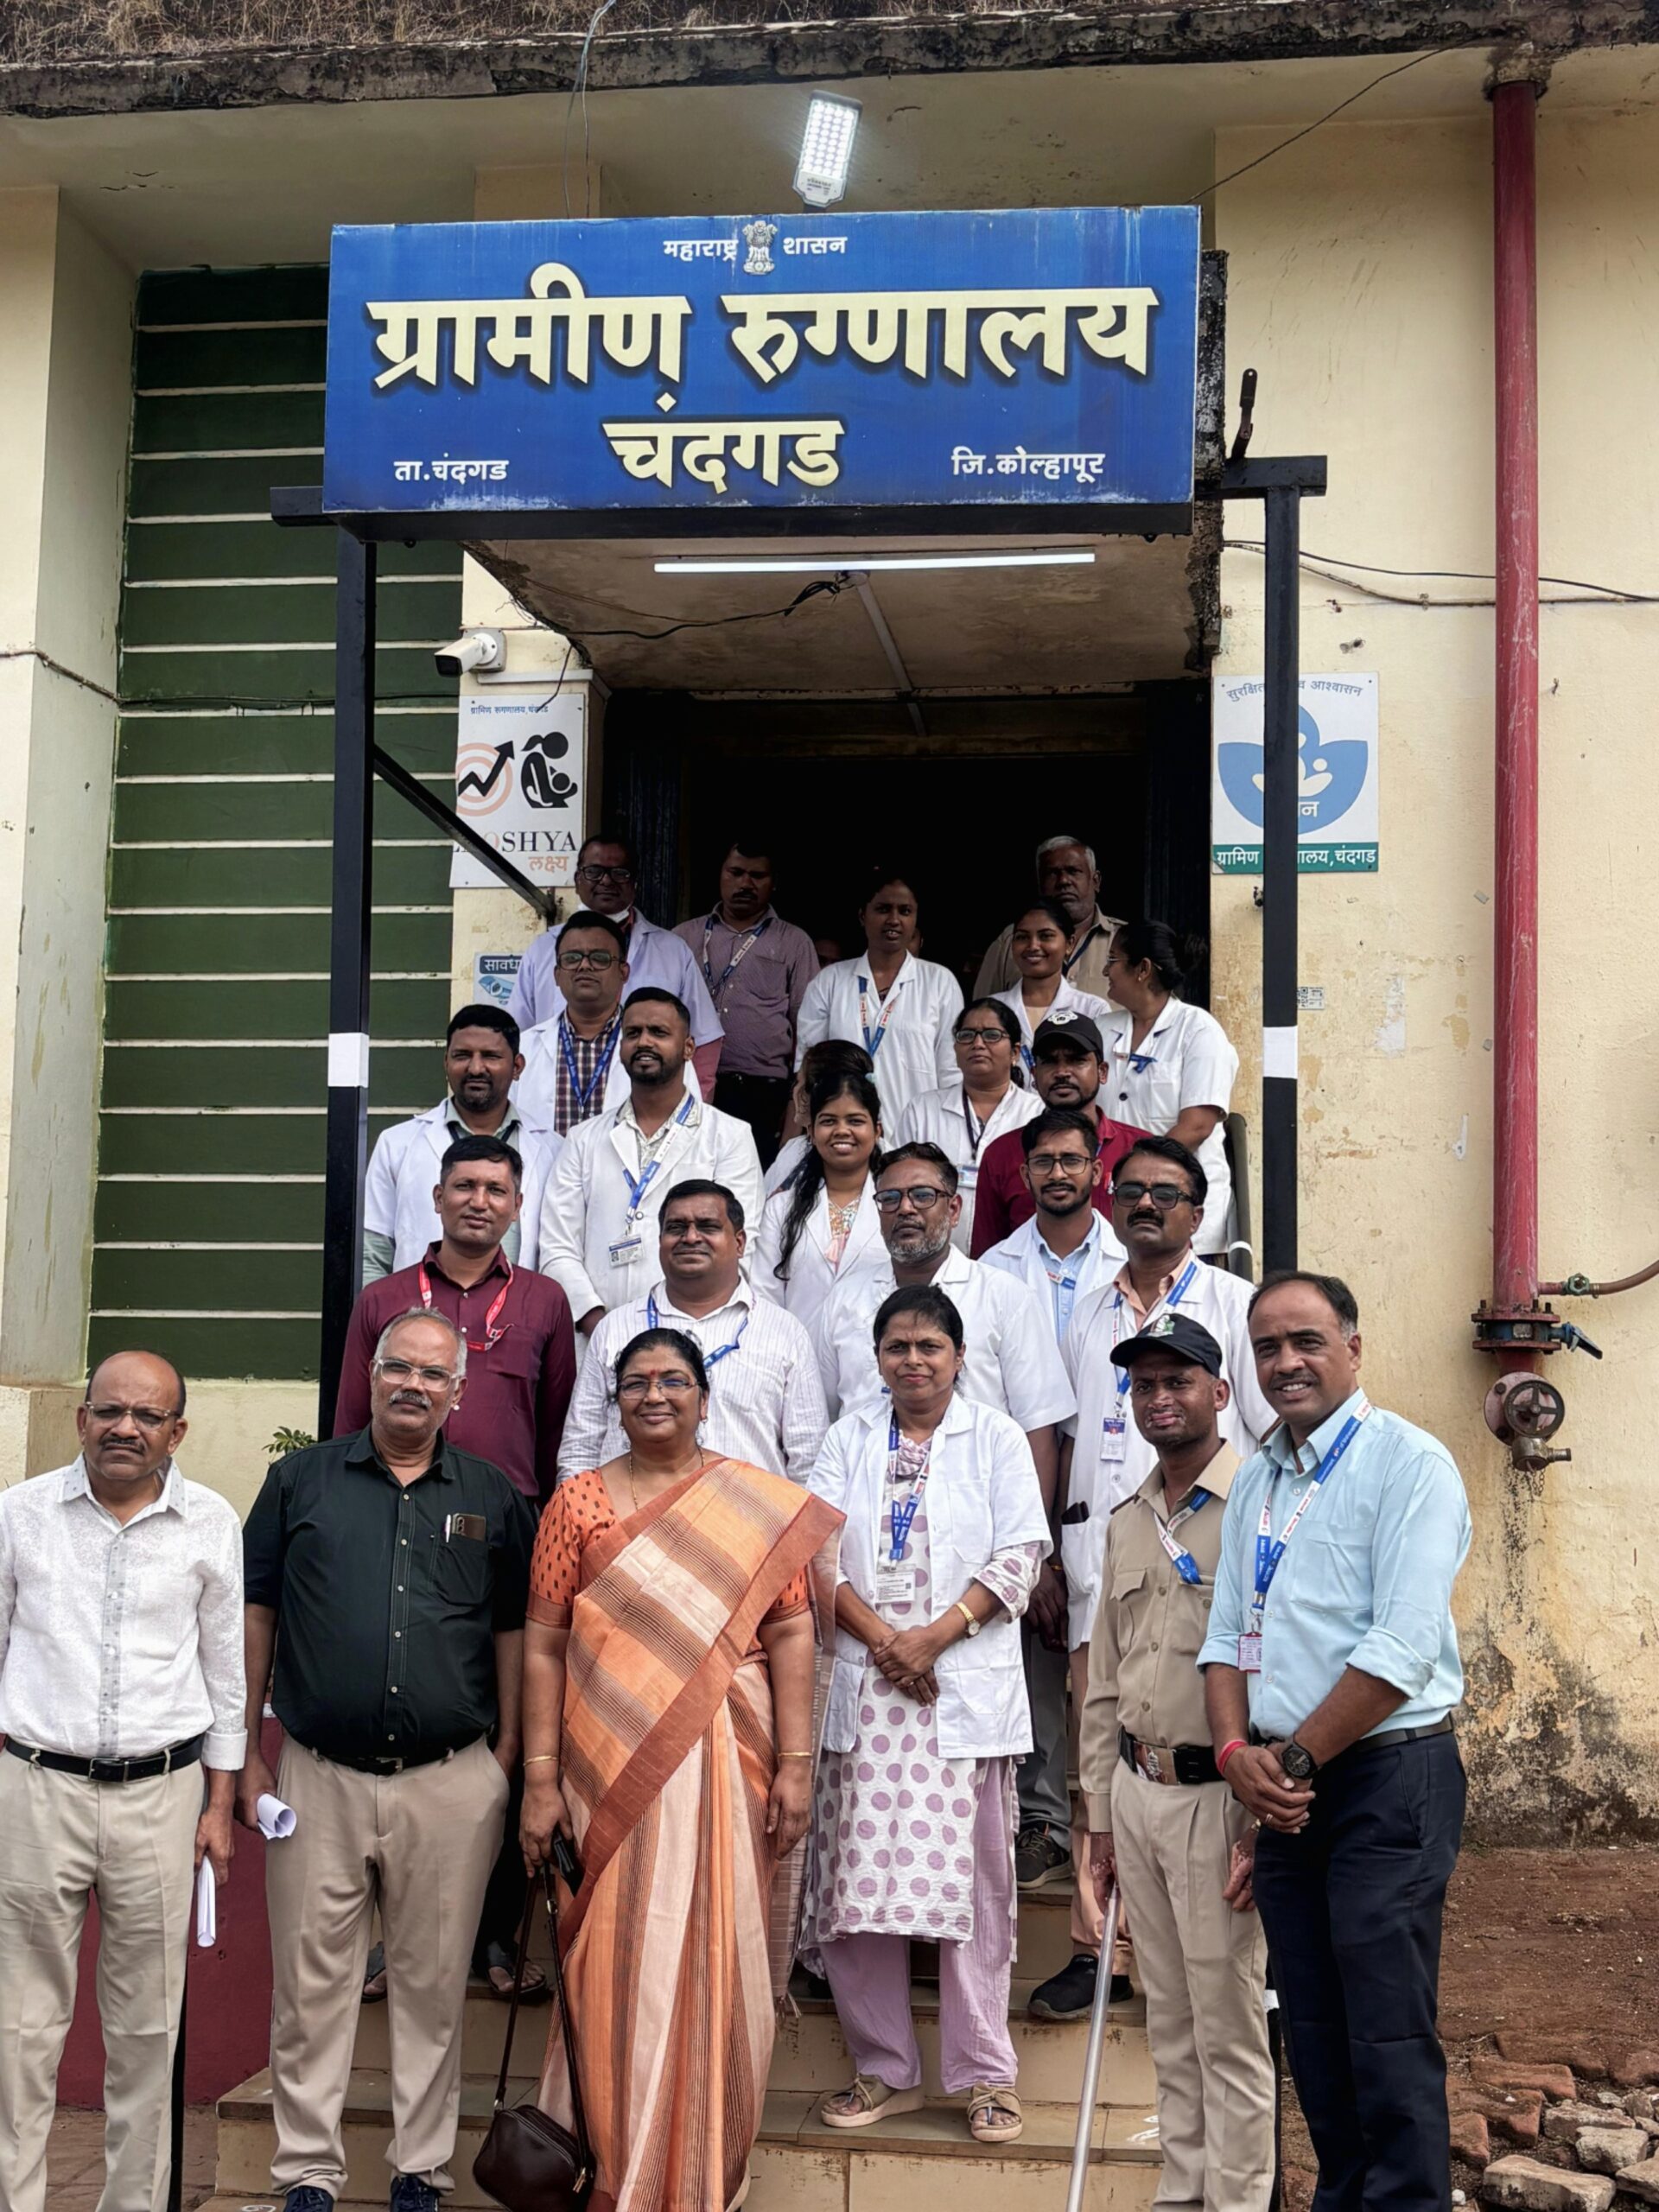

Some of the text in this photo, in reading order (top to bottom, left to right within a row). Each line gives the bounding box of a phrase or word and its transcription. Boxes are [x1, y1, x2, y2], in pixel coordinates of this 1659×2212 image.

[663, 236, 849, 262] महाराष्ट्र शासन
[365, 262, 1160, 389] ग्रामीण रुग्णालय
[602, 392, 845, 494] चंदगड
[1310, 679, 1363, 697] आश्वासन
[529, 855, 569, 873] लक्ष्य
[1216, 846, 1260, 865] ग्रामिण
[484, 958, 521, 971] सावध
